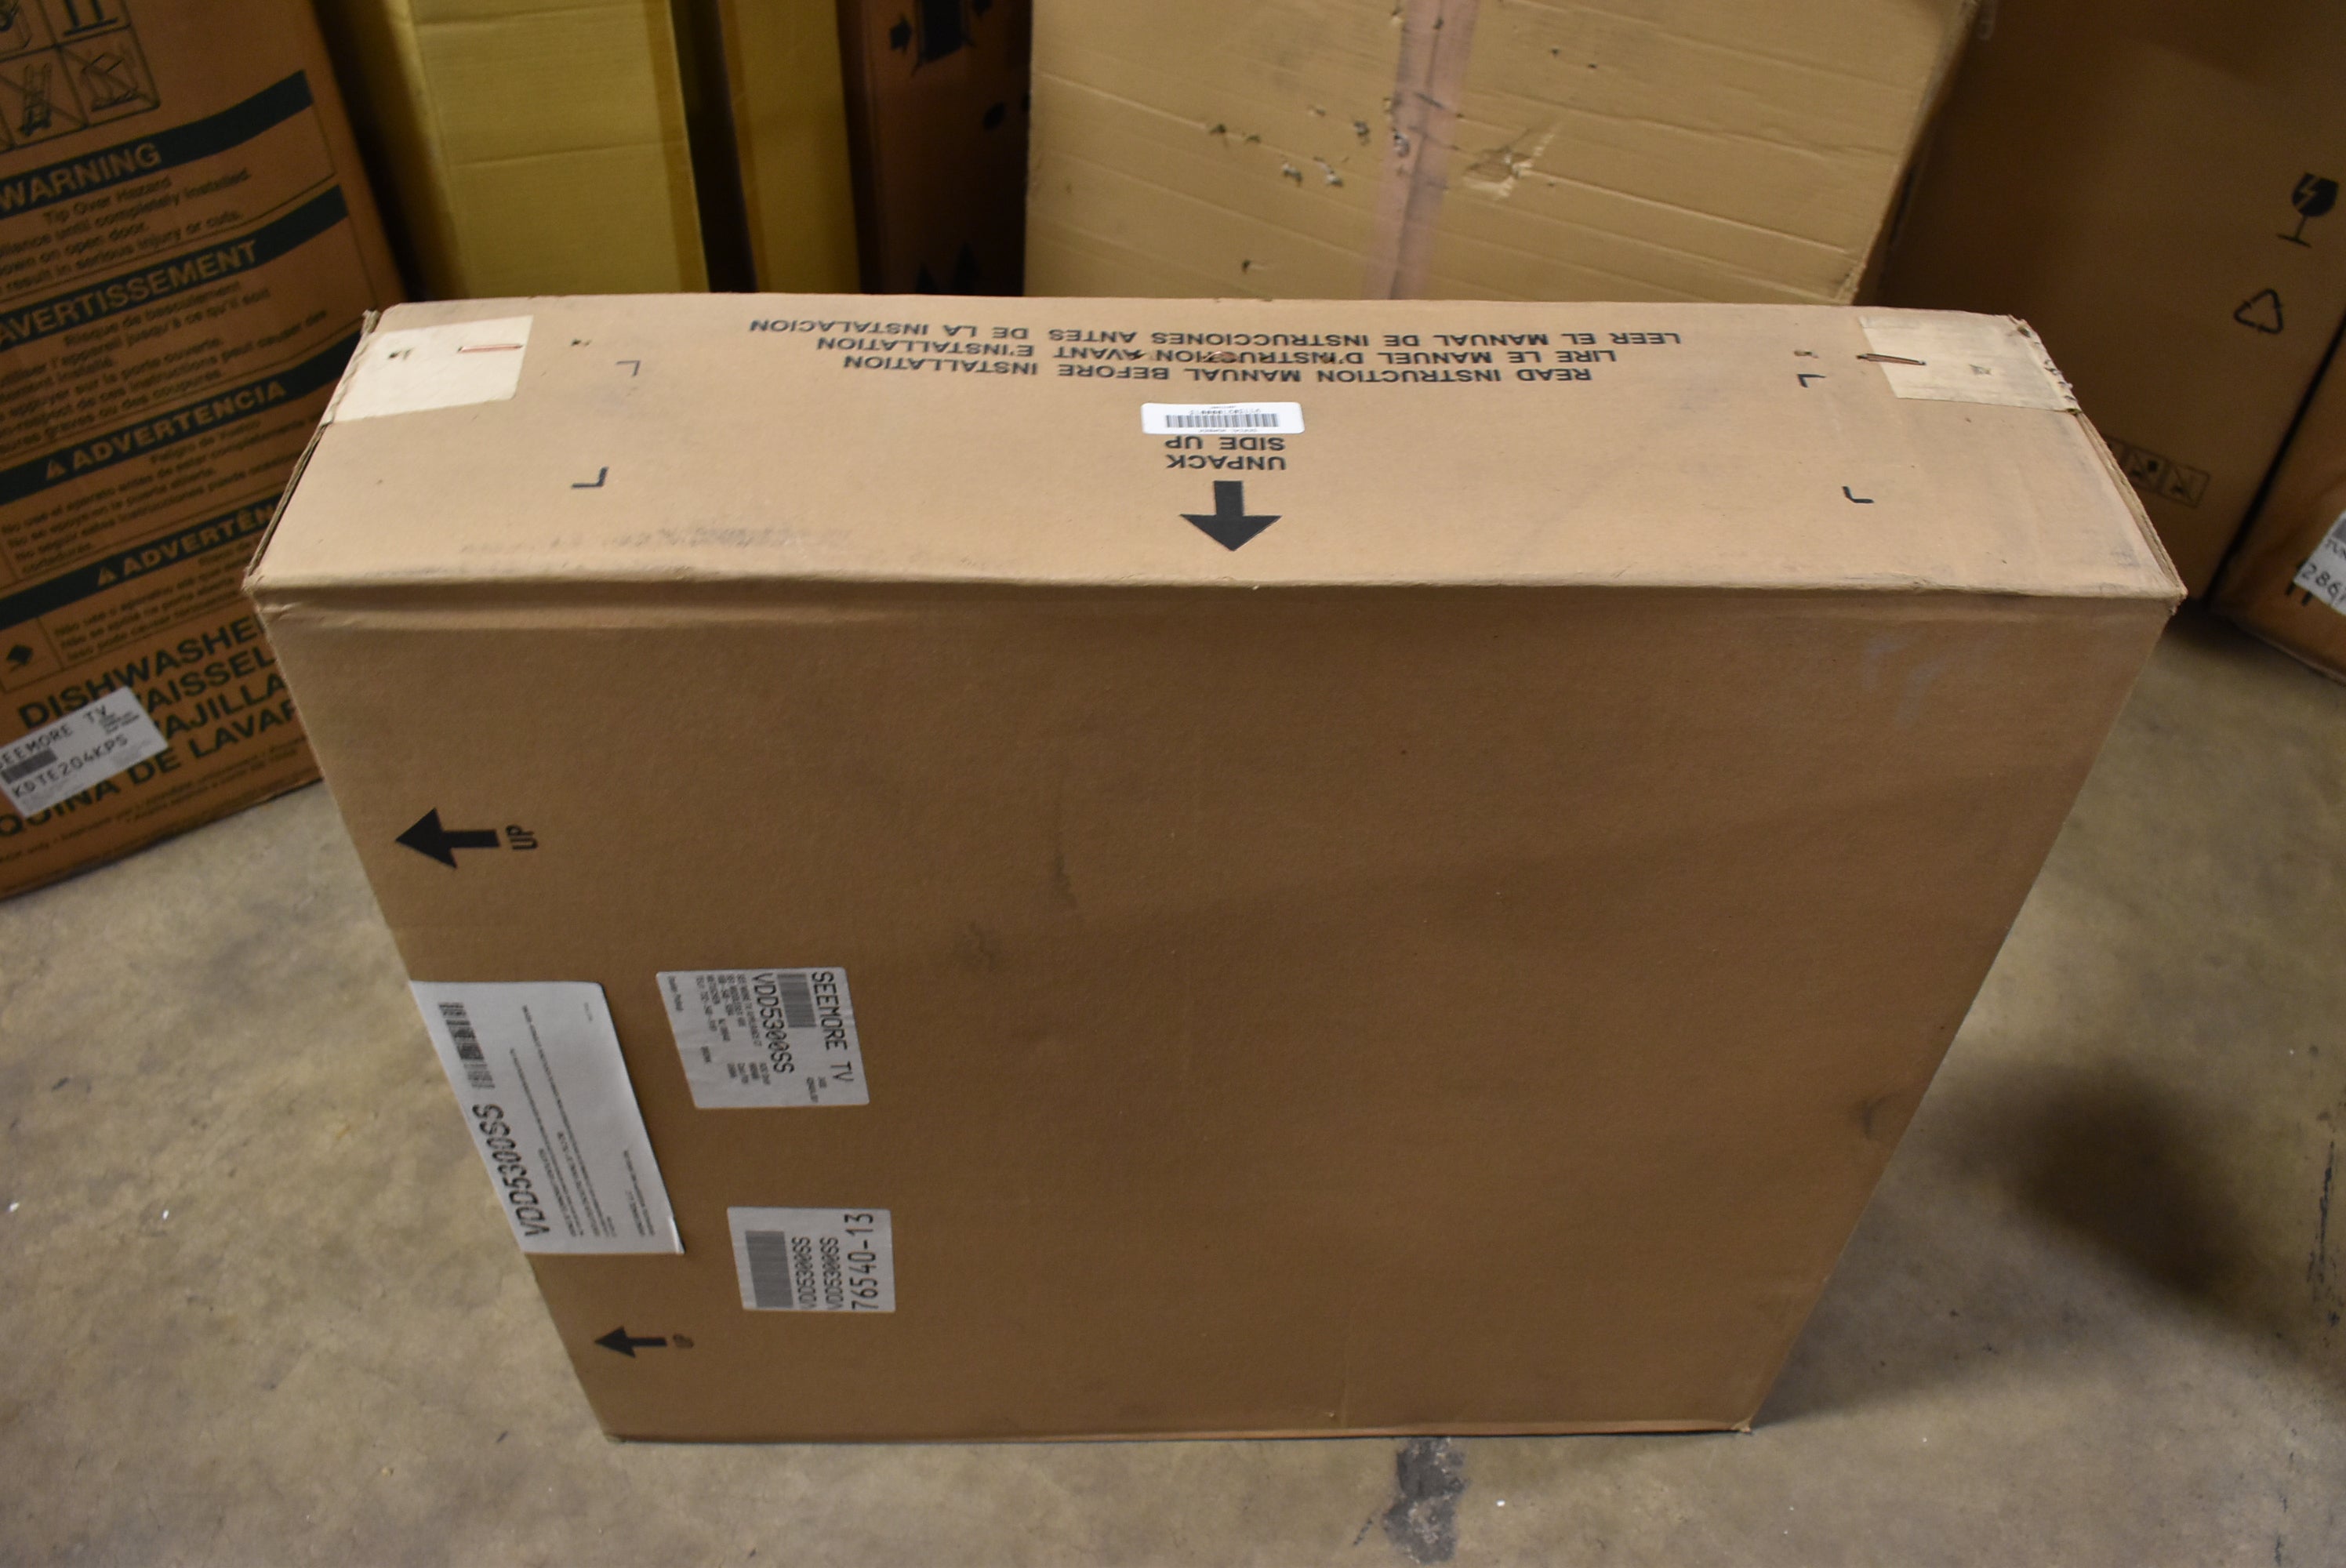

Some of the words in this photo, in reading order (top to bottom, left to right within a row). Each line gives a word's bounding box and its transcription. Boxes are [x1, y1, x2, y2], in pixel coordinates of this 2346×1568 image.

[0, 142, 162, 212] WARNING
[0, 240, 256, 343] AVERTISSEMENT
[750, 319, 929, 336] INSTALACION
[942, 324, 978, 339] LA
[993, 326, 1029, 342] DE
[1049, 328, 1137, 344] ANTES
[1150, 329, 1369, 349] INSTRUCCIONES
[1383, 333, 1419, 349] DE
[1433, 332, 1548, 348] MANUAL
[1563, 332, 1594, 347] EL
[1611, 332, 1681, 347] LEER
[1054, 346, 1138, 362] AVANT
[1378, 350, 1491, 366] MANUEL
[1507, 350, 1541, 365] LE
[1556, 349, 1616, 364] LIRE
[843, 355, 1038, 376] INSTALLATION
[1058, 363, 1169, 380] BEFORE
[1185, 367, 1302, 383] MANUAL
[1316, 368, 1501, 383] INSTRUCTION
[1516, 368, 1592, 382] READ
[73, 380, 287, 470] ADVERTENCIA
[1165, 435, 1203, 451] UP
[1218, 436, 1285, 452] SIDE
[1164, 454, 1287, 470] UNPACK
[19, 612, 267, 729] DISHWASHE
[135, 646, 277, 713] AISSEL
[154, 672, 288, 740] AJILLA
[127, 746, 182, 785] DE
[505, 824, 539, 851] UP
[751, 972, 795, 1074] VDD5300SS
[812, 971, 848, 1051] SEEMORE
[830, 1061, 855, 1083] TV
[470, 1104, 552, 1238] VDD5300SS
[844, 1213, 880, 1310] 76540-13
